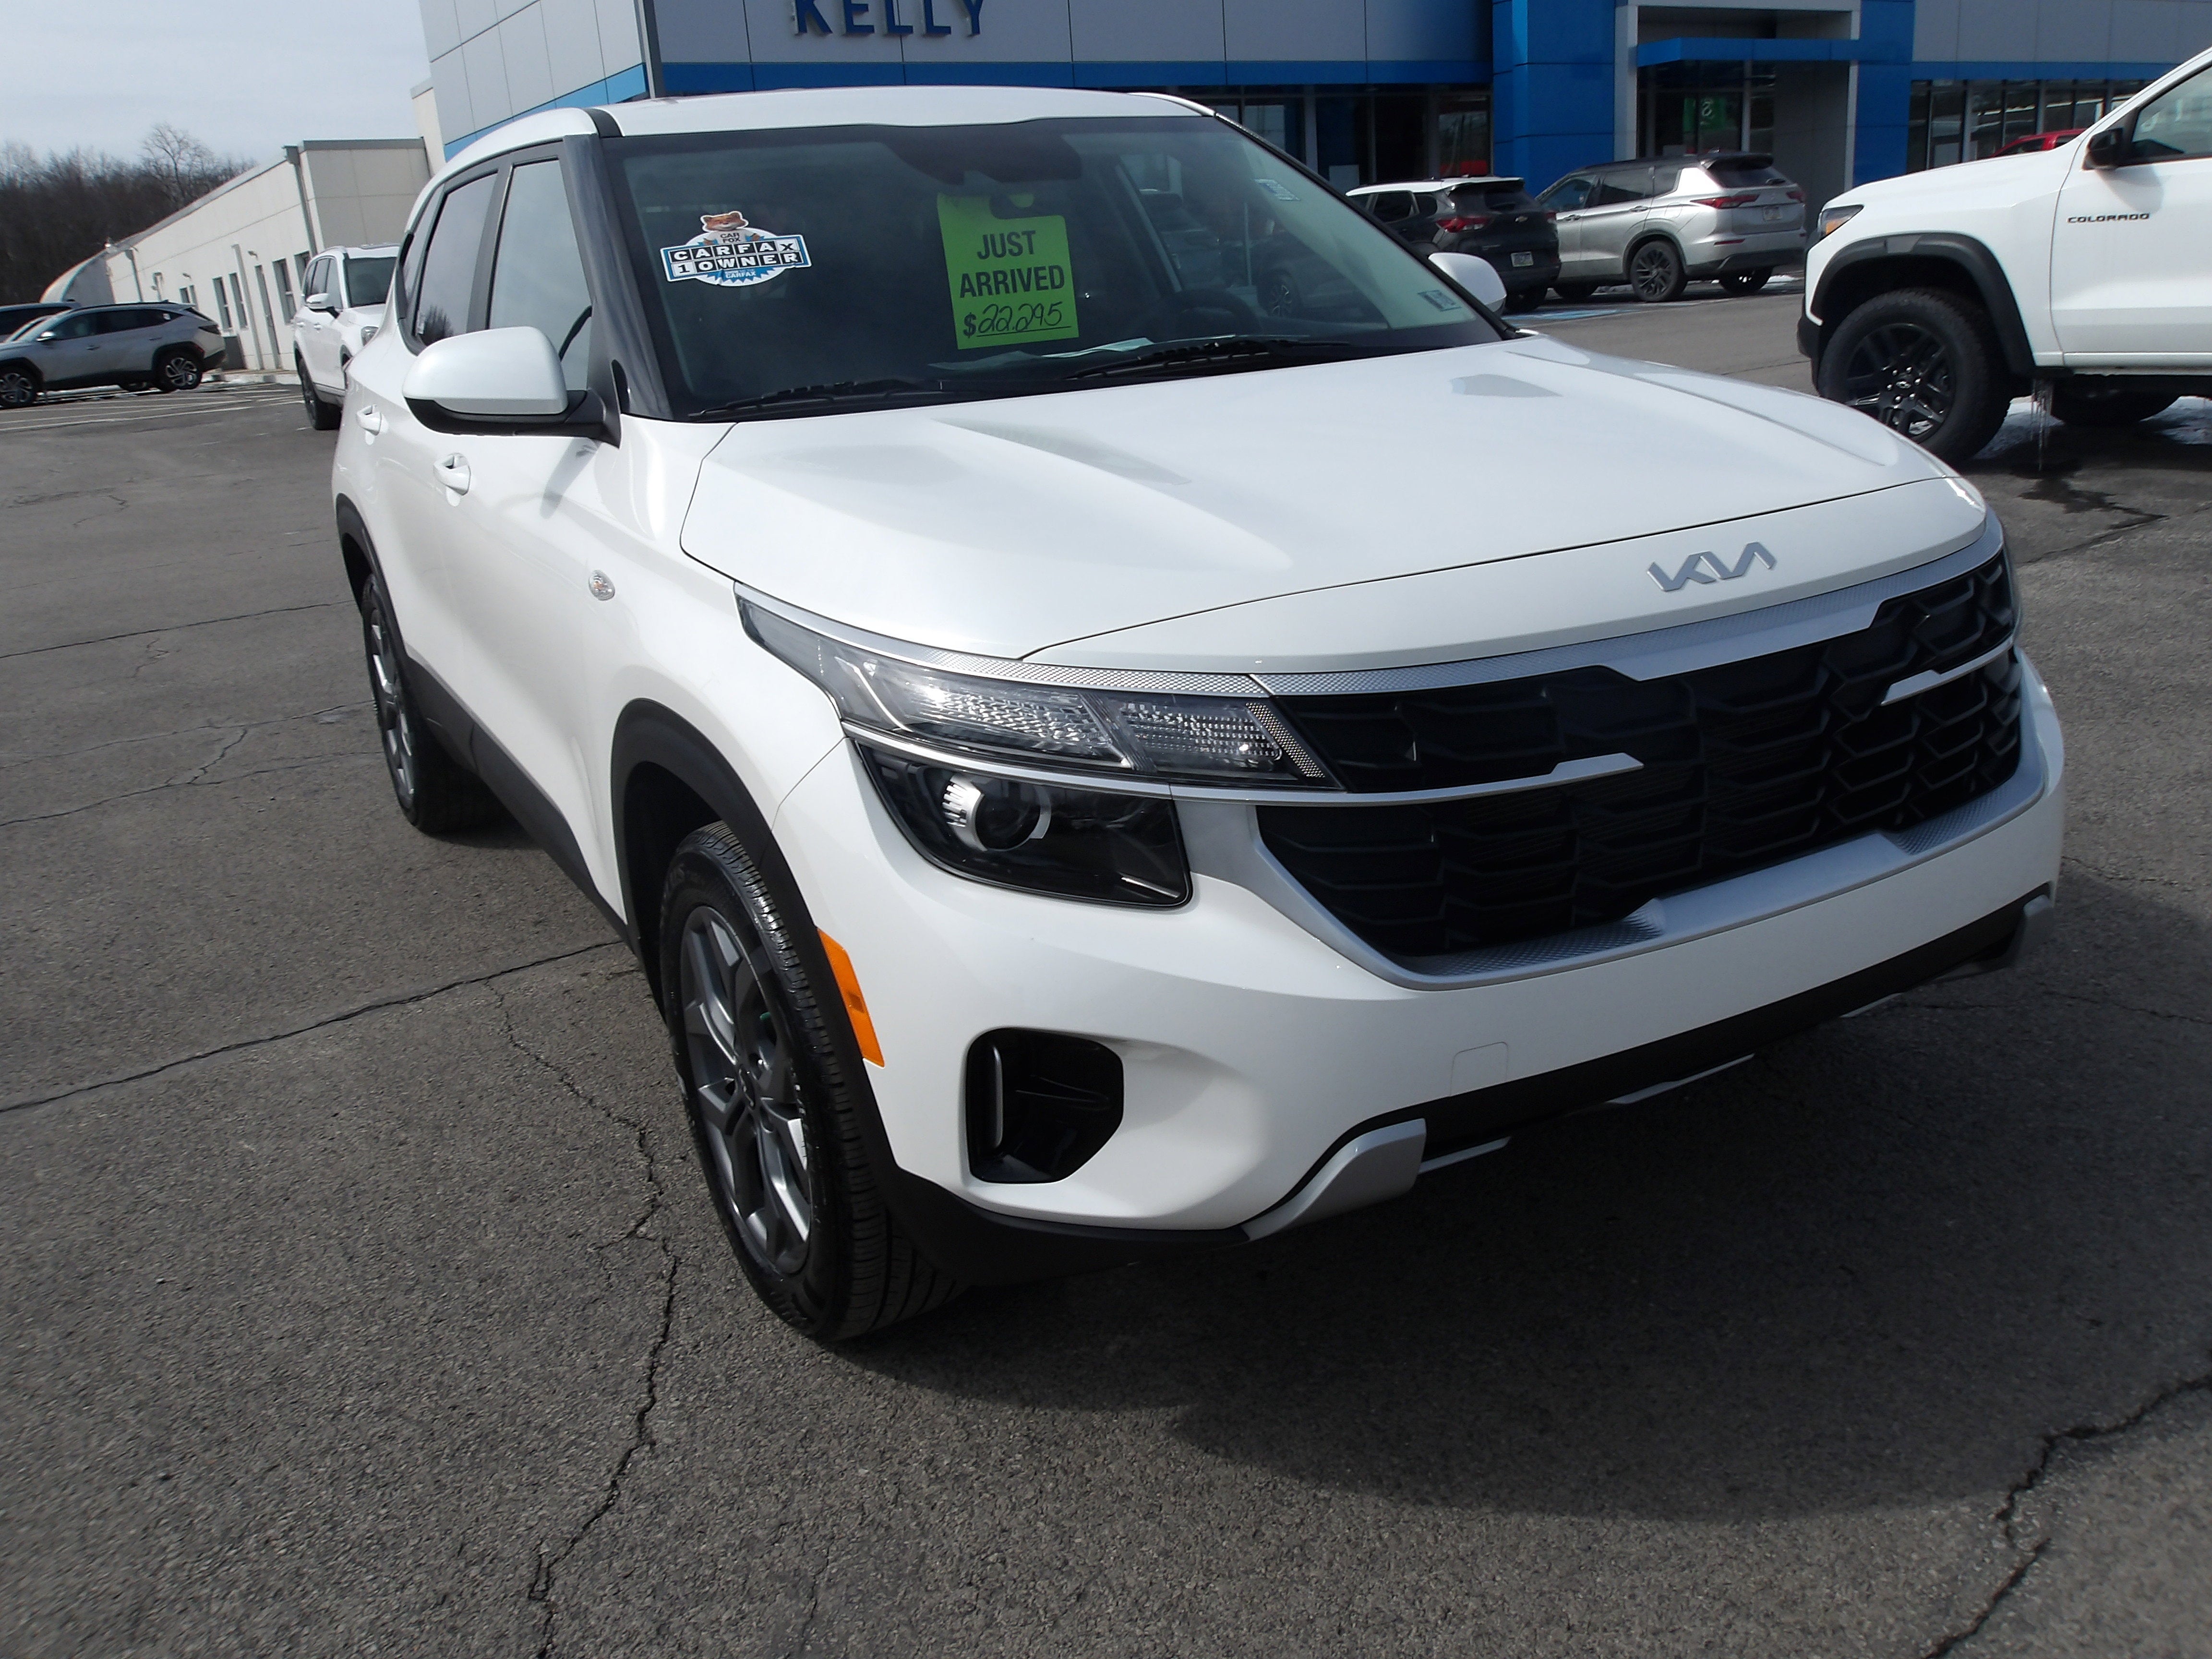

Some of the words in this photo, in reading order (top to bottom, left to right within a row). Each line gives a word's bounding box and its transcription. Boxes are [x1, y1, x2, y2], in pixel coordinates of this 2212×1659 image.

[794, 0, 983, 35] KELLY
[2068, 213, 2150, 223] COLORADO
[673, 242, 795, 261] CARFAX
[977, 230, 1036, 260] JUST
[678, 264, 690, 274] 1
[697, 253, 798, 271] OWNER
[960, 264, 1065, 298] ARRIVED
